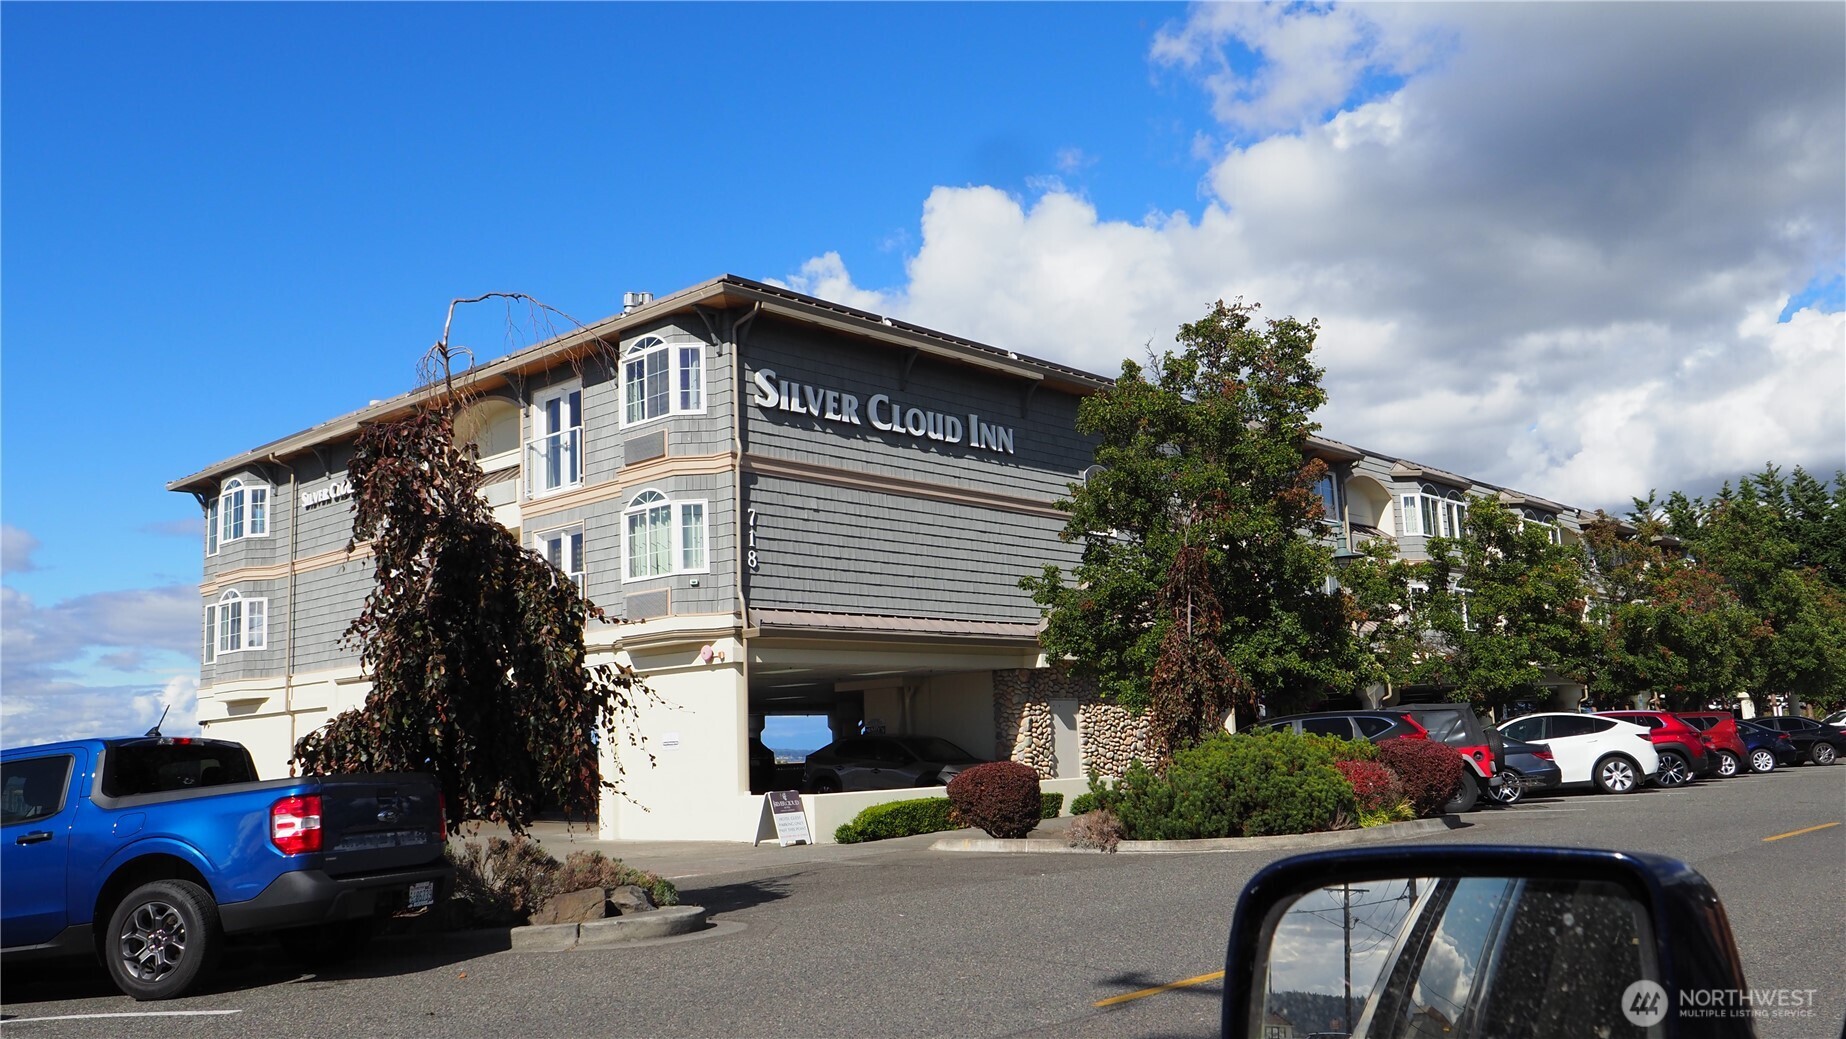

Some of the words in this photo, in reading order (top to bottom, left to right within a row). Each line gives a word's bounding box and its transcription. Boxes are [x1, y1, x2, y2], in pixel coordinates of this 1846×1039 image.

[754, 368, 861, 425] SILVER
[866, 393, 962, 444] CLOUD
[967, 413, 1014, 455] INN
[301, 488, 330, 507] SILVER
[747, 508, 757, 568] 718
